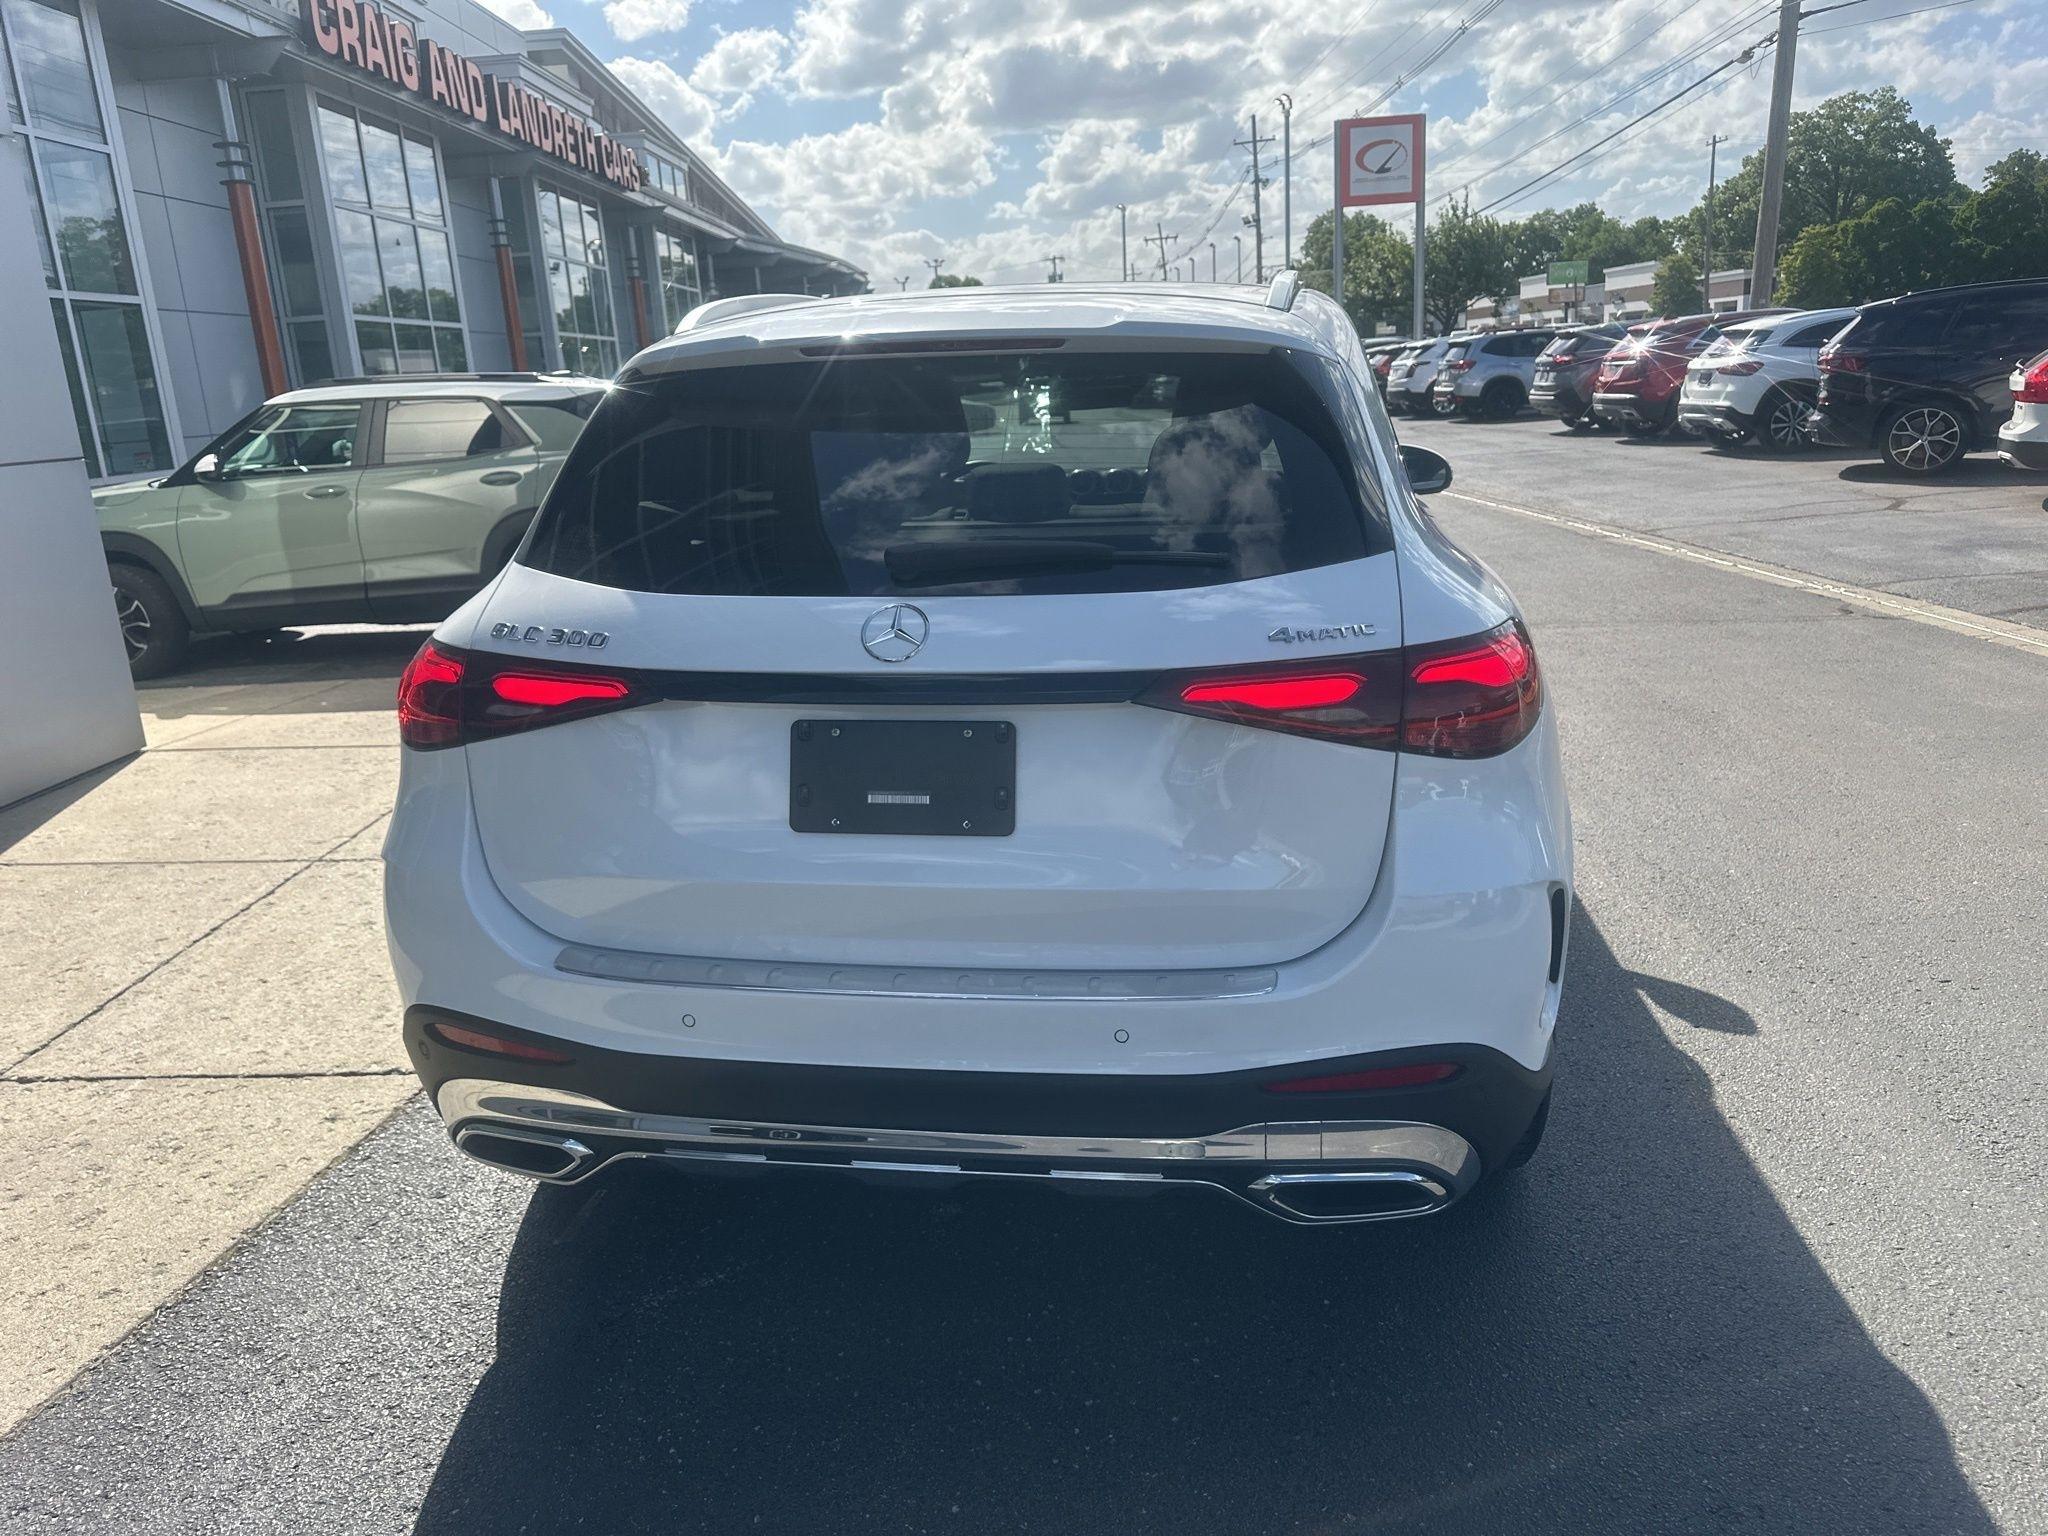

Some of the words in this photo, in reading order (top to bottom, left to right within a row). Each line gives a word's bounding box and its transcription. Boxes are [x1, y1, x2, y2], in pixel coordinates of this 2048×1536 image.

[310, 0, 419, 92] CRAIG
[428, 39, 488, 123] AND
[492, 73, 599, 174] LANDRETH
[600, 133, 641, 192] CARS
[490, 622, 544, 643] GLC
[546, 628, 610, 649] 300
[1267, 623, 1377, 643] 4MATIC
